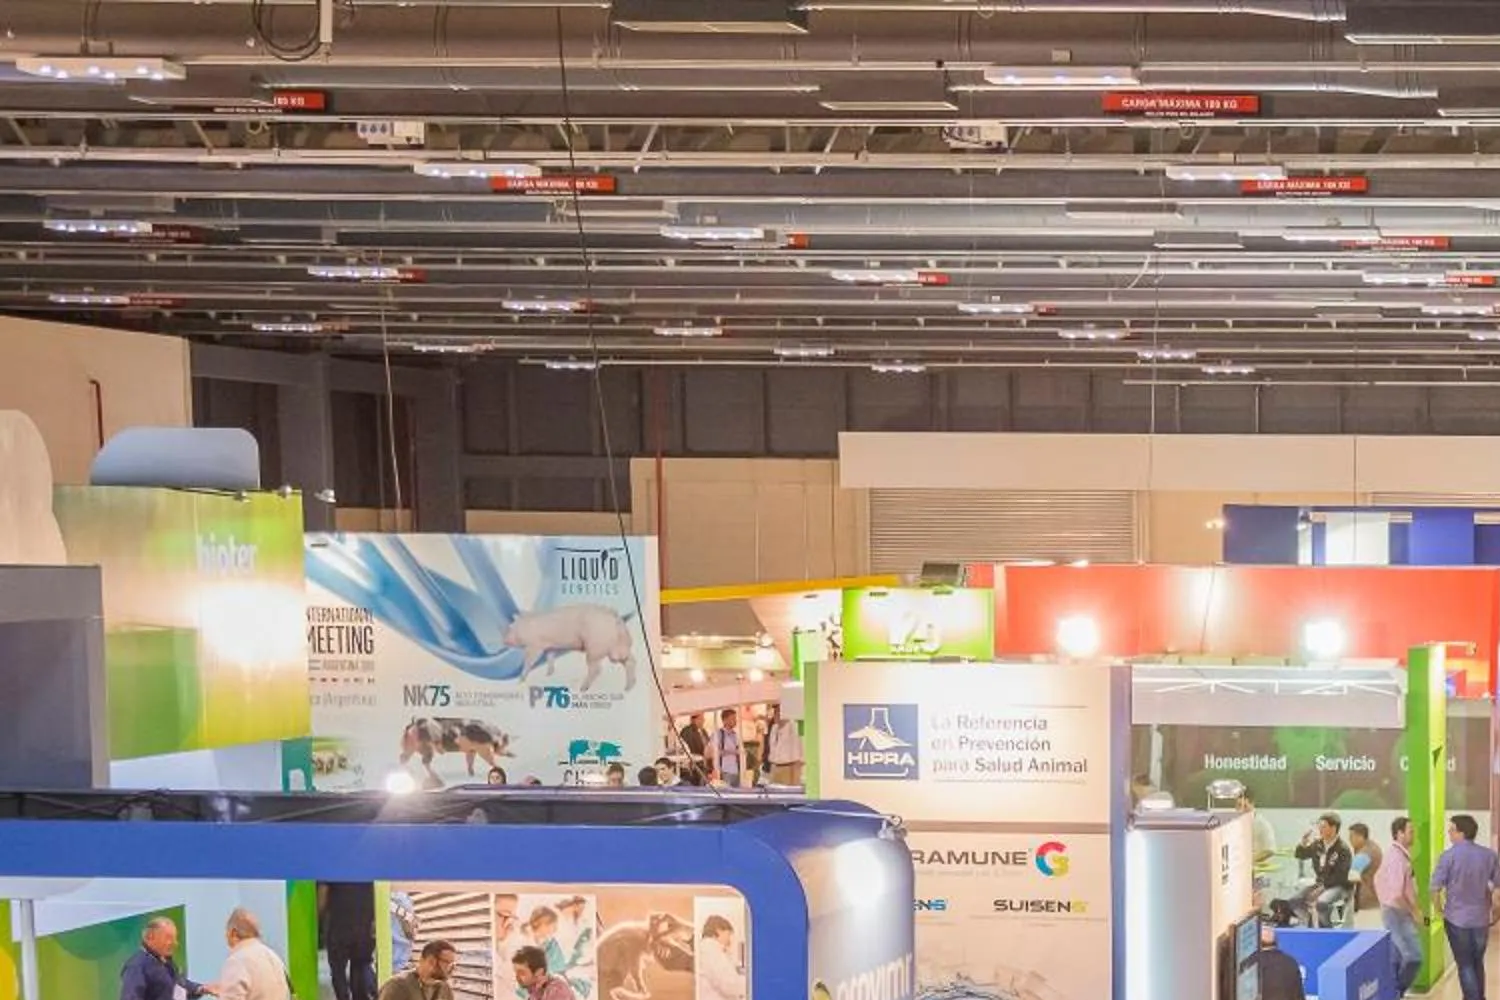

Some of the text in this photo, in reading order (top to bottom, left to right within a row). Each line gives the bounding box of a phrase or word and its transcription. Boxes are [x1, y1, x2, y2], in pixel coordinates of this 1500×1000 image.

[1121, 99, 1156, 109] CARGA
[1223, 99, 1238, 109] KG
[561, 550, 619, 580] LIQUID
[306, 607, 374, 622] NTERNATIONAL
[403, 685, 451, 707] NK75
[529, 686, 571, 709] P76
[957, 714, 1048, 731] Referencia
[959, 735, 1051, 752] Prevención
[847, 751, 916, 766] HIPRA
[975, 757, 1024, 773] Salud
[1027, 758, 1088, 774] Animal
[1204, 754, 1377, 772] Honestidad Servicio
[911, 850, 1028, 866] RAMUNE
